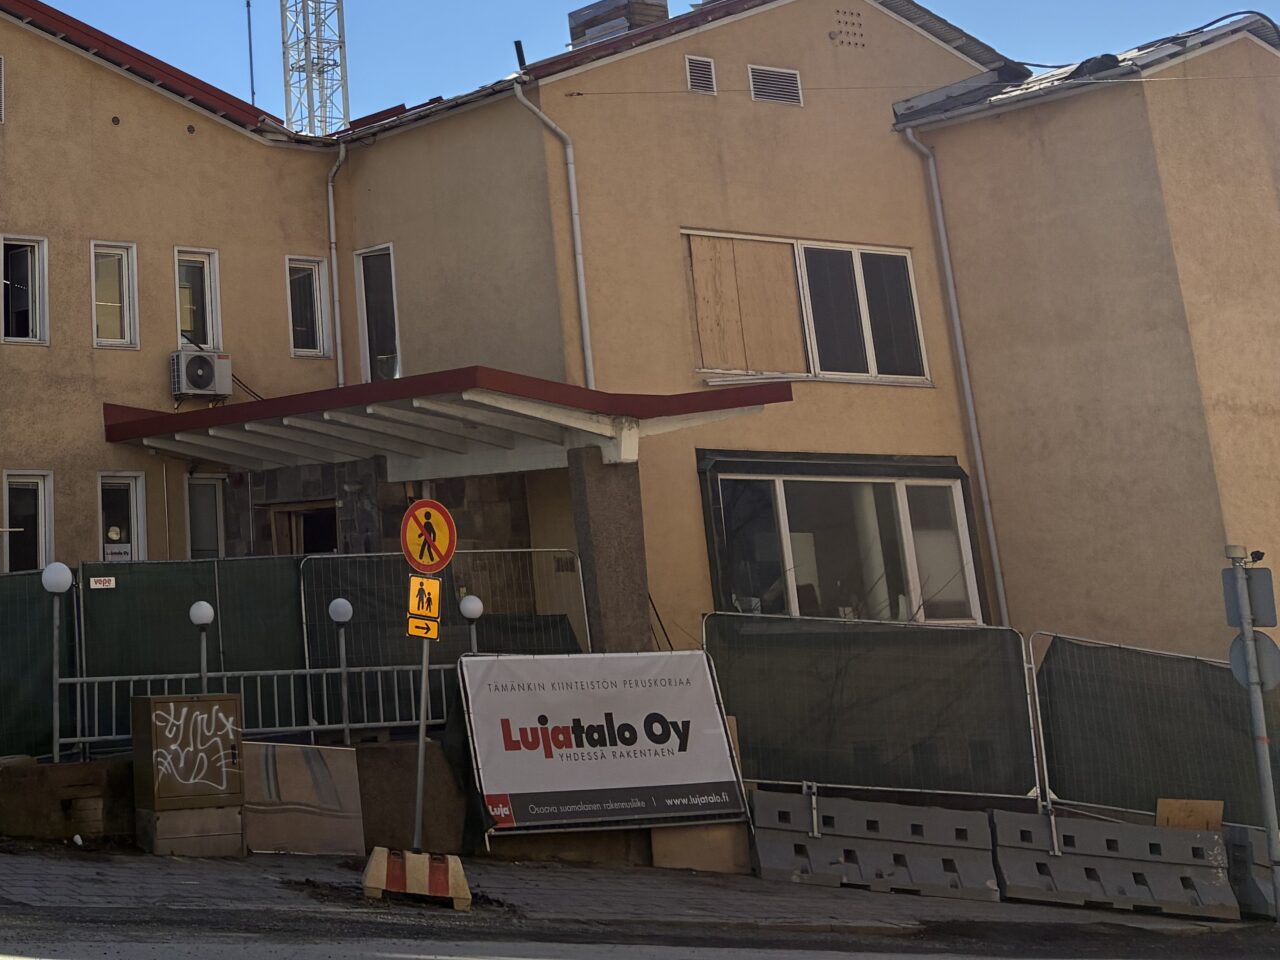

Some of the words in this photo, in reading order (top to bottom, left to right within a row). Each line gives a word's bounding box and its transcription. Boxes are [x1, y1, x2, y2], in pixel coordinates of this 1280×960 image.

[487, 681, 546, 693] TÄMÄNKIN
[551, 679, 618, 692] KIINTEISTÖN
[623, 678, 692, 689] PERUSKORJAA
[500, 712, 638, 759] Lujatalo
[643, 712, 691, 752] Oy
[558, 750, 606, 762] YHDESSÄ
[612, 748, 675, 760] RAKENTAEN
[528, 804, 558, 814] Osaava
[560, 801, 602, 813] suomalainen
[603, 798, 646, 809] rakennusliike
[665, 792, 729, 806] www.lujatalo.fi
[488, 803, 510, 817] Luja
